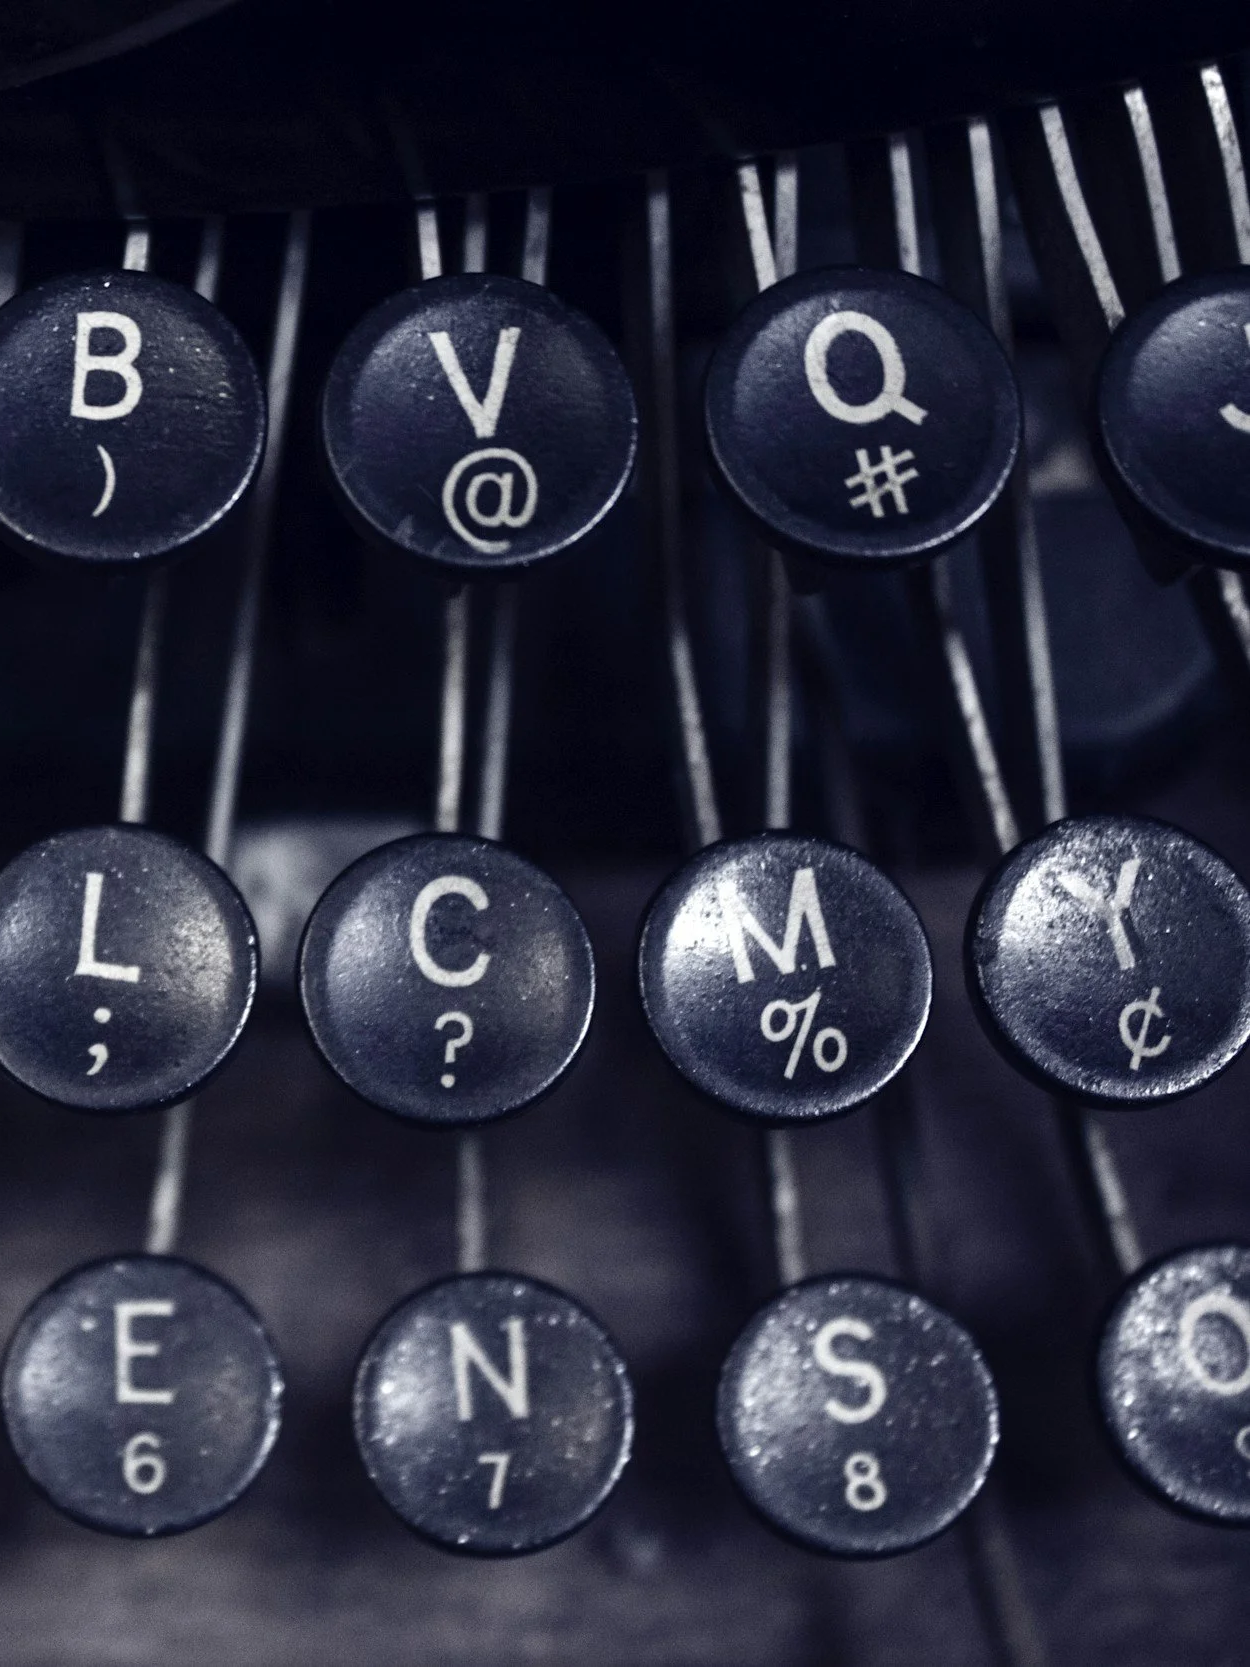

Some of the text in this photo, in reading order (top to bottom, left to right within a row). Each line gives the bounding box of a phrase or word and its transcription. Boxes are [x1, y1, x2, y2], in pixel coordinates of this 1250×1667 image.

[71, 311, 144, 421] B
[429, 327, 521, 438] V
[804, 310, 929, 425] Q
[92, 444, 116, 517] )
[442, 448, 538, 553] @
[844, 446, 918, 517] #
[75, 872, 140, 982] L
[409, 875, 491, 987] C
[717, 867, 836, 983] M
[1056, 858, 1141, 970] Y
[86, 1007, 111, 1075] ;
[434, 1011, 474, 1089] ?
[760, 990, 847, 1080] %
[1119, 987, 1171, 1070] ¢
[114, 1300, 176, 1404] E
[450, 1317, 529, 1421] N
[813, 1317, 887, 1424] S
[122, 1433, 167, 1494] 6
[478, 1452, 511, 1510] 7
[843, 1452, 888, 1512] 8
